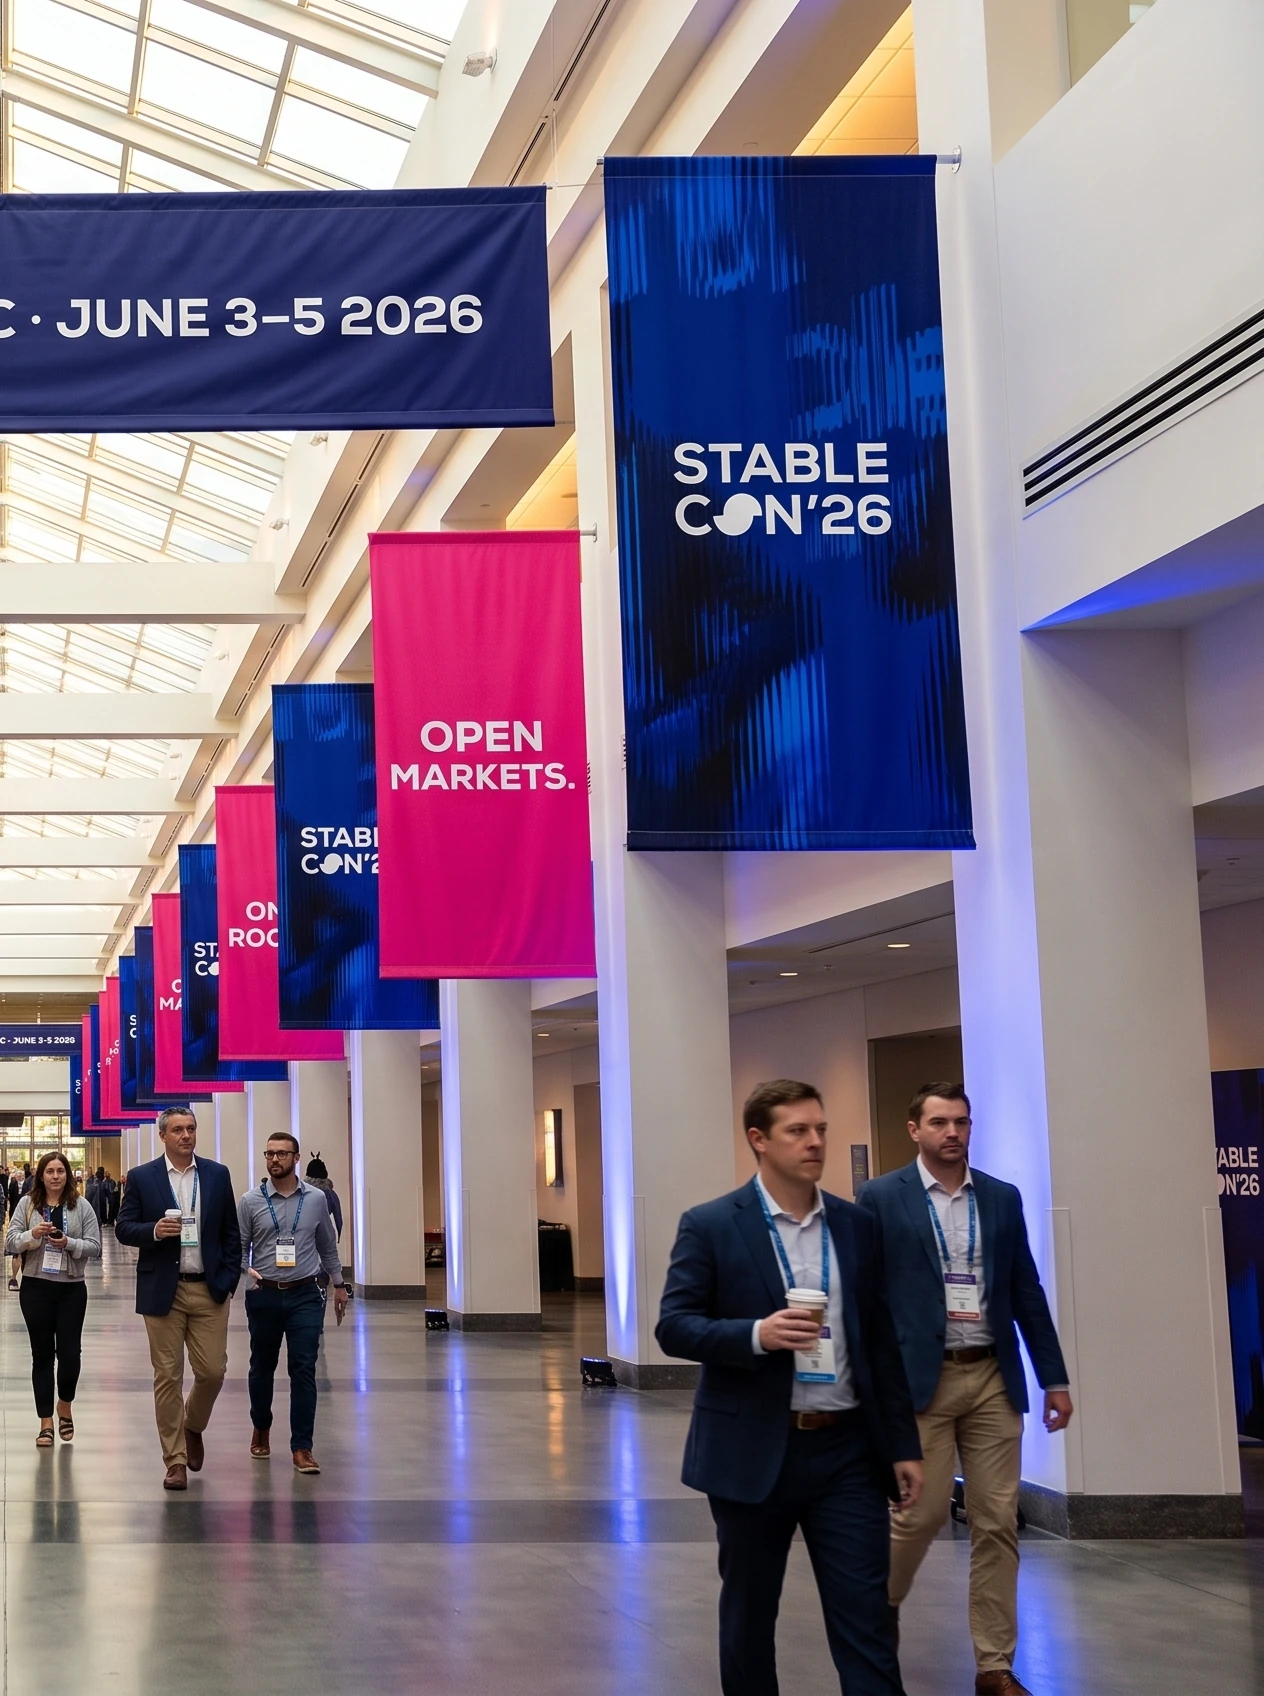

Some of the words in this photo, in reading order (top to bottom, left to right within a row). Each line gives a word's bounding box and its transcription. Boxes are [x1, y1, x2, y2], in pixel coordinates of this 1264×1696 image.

[56, 298, 210, 339] JUNE
[224, 297, 325, 337] 3–5
[340, 294, 483, 336] 2026
[673, 442, 889, 485] STABLE
[420, 720, 543, 753] OPEN
[390, 762, 576, 790] MARKETS.
[1216, 1146, 1259, 1168] ABLE
